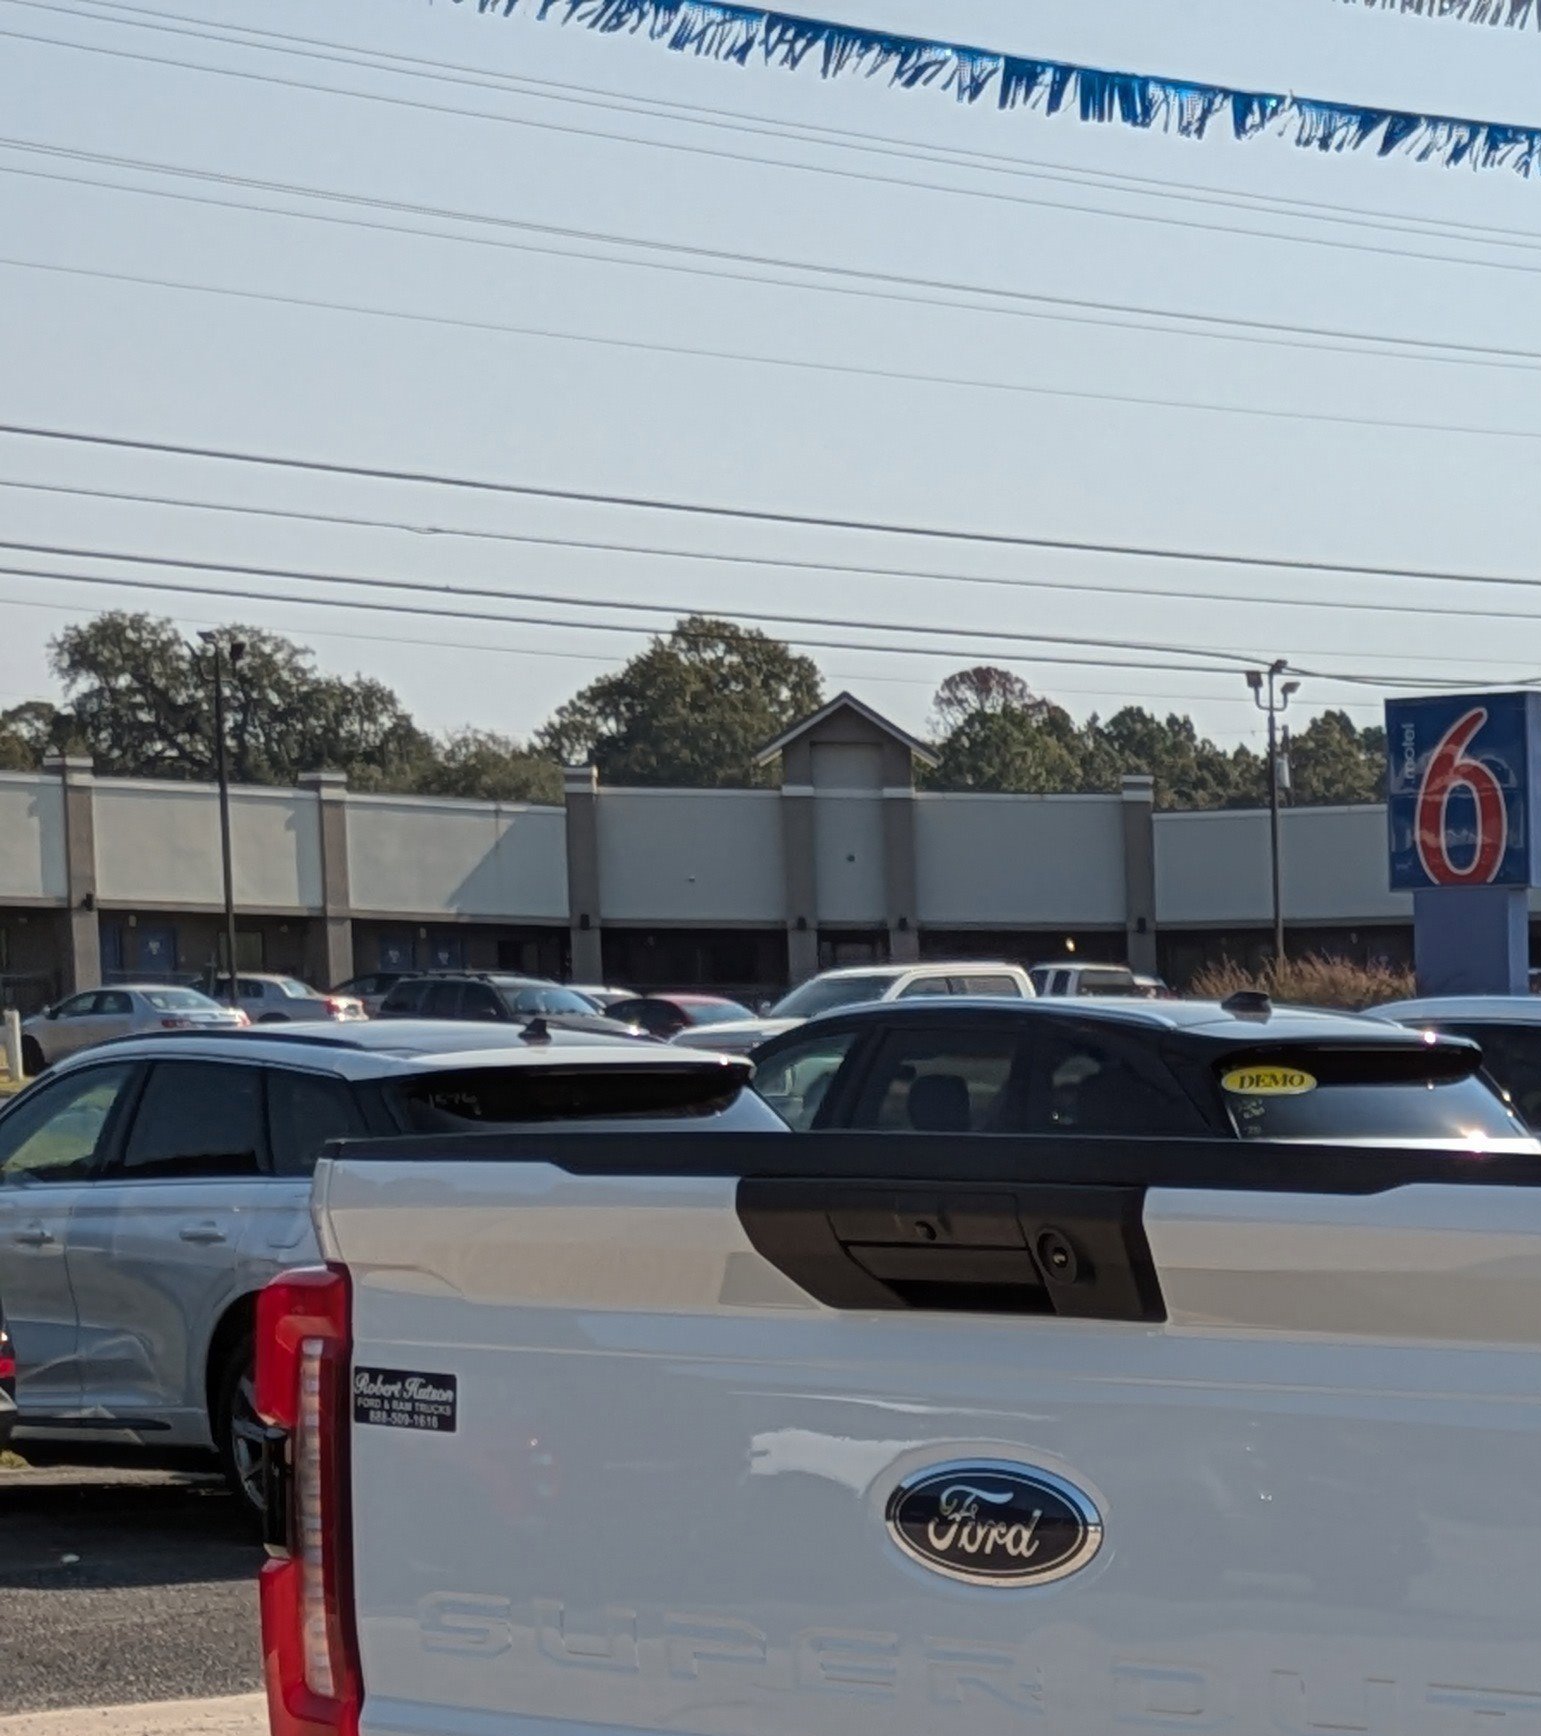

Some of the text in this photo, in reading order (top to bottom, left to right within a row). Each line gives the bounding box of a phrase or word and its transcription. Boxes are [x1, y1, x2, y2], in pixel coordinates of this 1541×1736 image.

[1402, 706, 1508, 886] motel 6
[1239, 1072, 1305, 1090] DEMO
[355, 1372, 454, 1402] Robert Hutson
[357, 1397, 382, 1409] FORD
[392, 1400, 412, 1412] RAM
[414, 1402, 452, 1417] TRUCKS
[368, 1410, 439, 1429] 888-509-1616
[927, 1484, 1043, 1558] Ford
[418, 1590, 1046, 1718] SUPER
